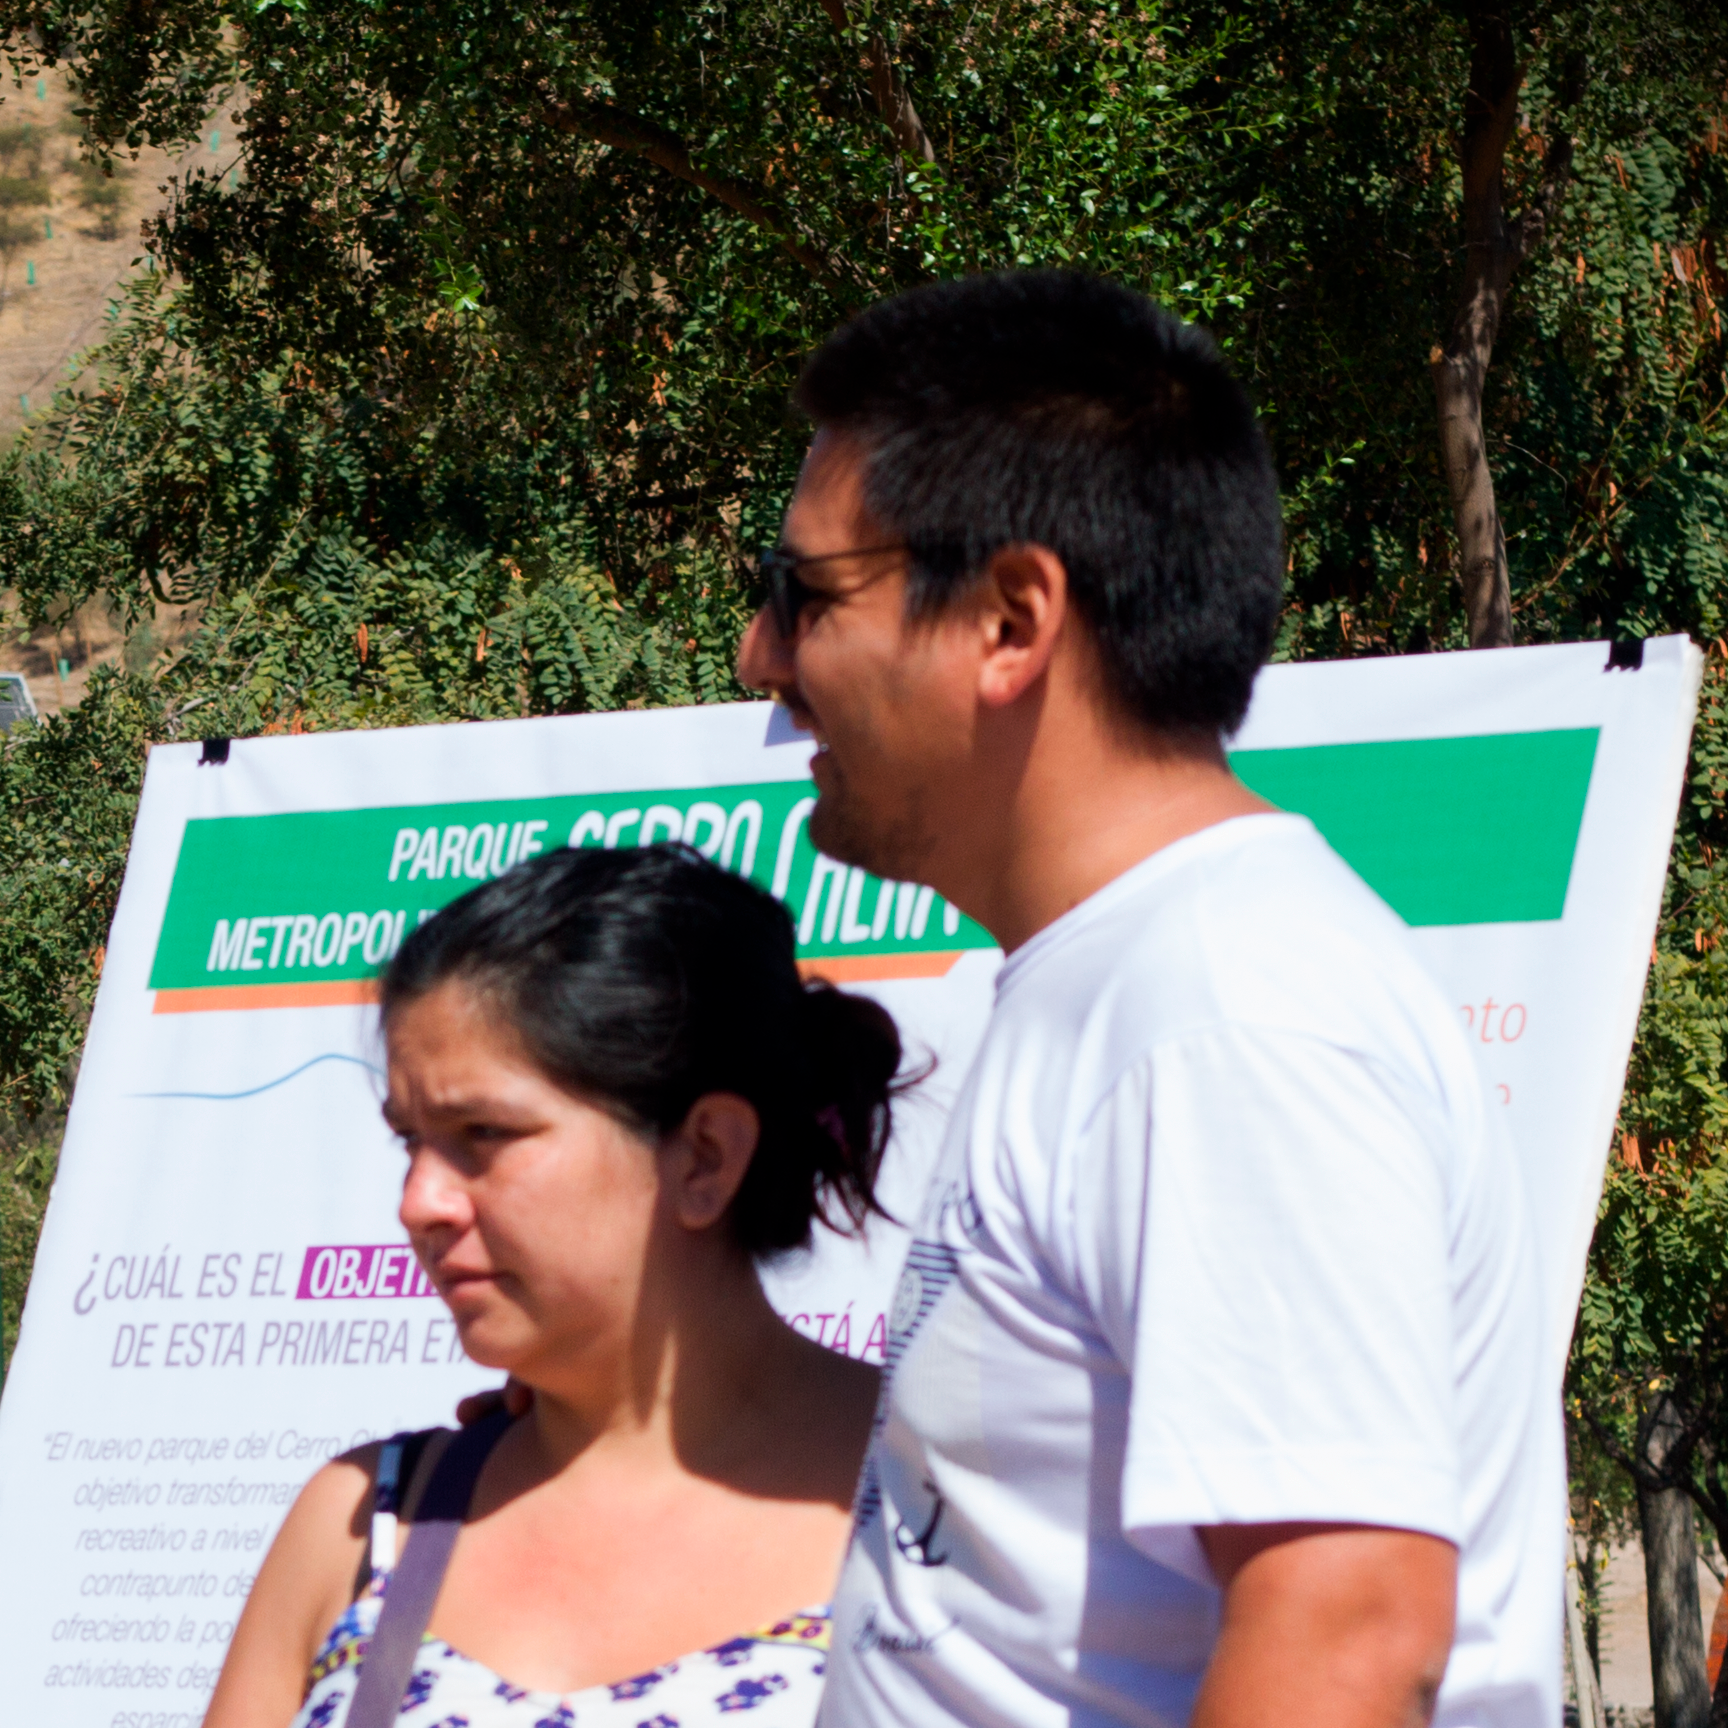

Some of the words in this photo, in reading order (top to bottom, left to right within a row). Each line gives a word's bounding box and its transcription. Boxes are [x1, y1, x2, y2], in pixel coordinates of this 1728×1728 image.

[74, 1243, 184, 1315] ¿CUÁL
[197, 1253, 242, 1299] ES
[249, 1252, 286, 1298] EL
[110, 1323, 158, 1368] DE
[164, 1321, 246, 1368] ESTA
[256, 1320, 408, 1366] PRIMERA
[73, 1438, 143, 1461] nuevo
[144, 1436, 230, 1466] parque
[233, 1430, 274, 1461] del
[276, 1429, 343, 1461] Cerro
[73, 1477, 162, 1512] objetivo
[75, 1525, 188, 1552] recreativo
[190, 1527, 208, 1552] a
[211, 1522, 270, 1552] nivel
[80, 1569, 219, 1603] contrapunto
[51, 1612, 171, 1643] ofreciendo
[174, 1613, 196, 1643] la
[44, 1659, 173, 1689] actividades
